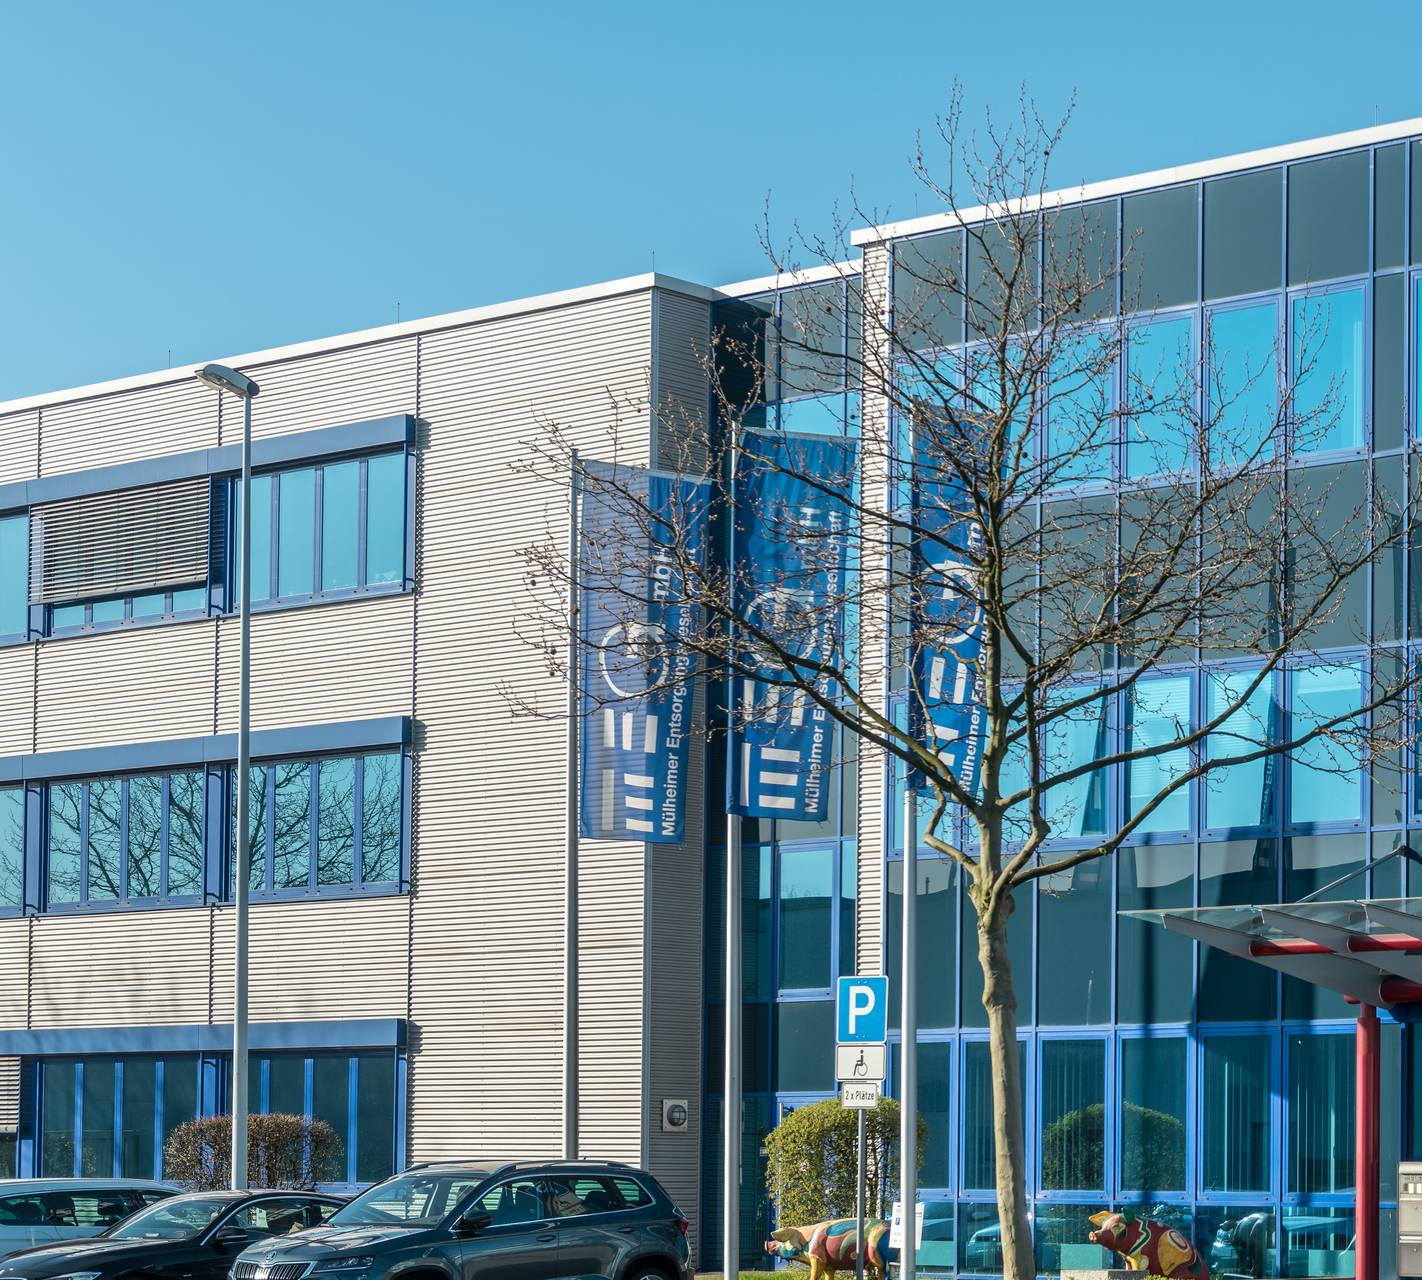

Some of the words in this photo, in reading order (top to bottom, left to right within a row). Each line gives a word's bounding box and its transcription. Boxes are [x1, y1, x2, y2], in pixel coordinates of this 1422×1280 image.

[660, 752, 680, 836] Mülheimer
[803, 725, 824, 814] Mülheimer
[848, 985, 876, 1034] P
[855, 1090, 875, 1101] Plätze
